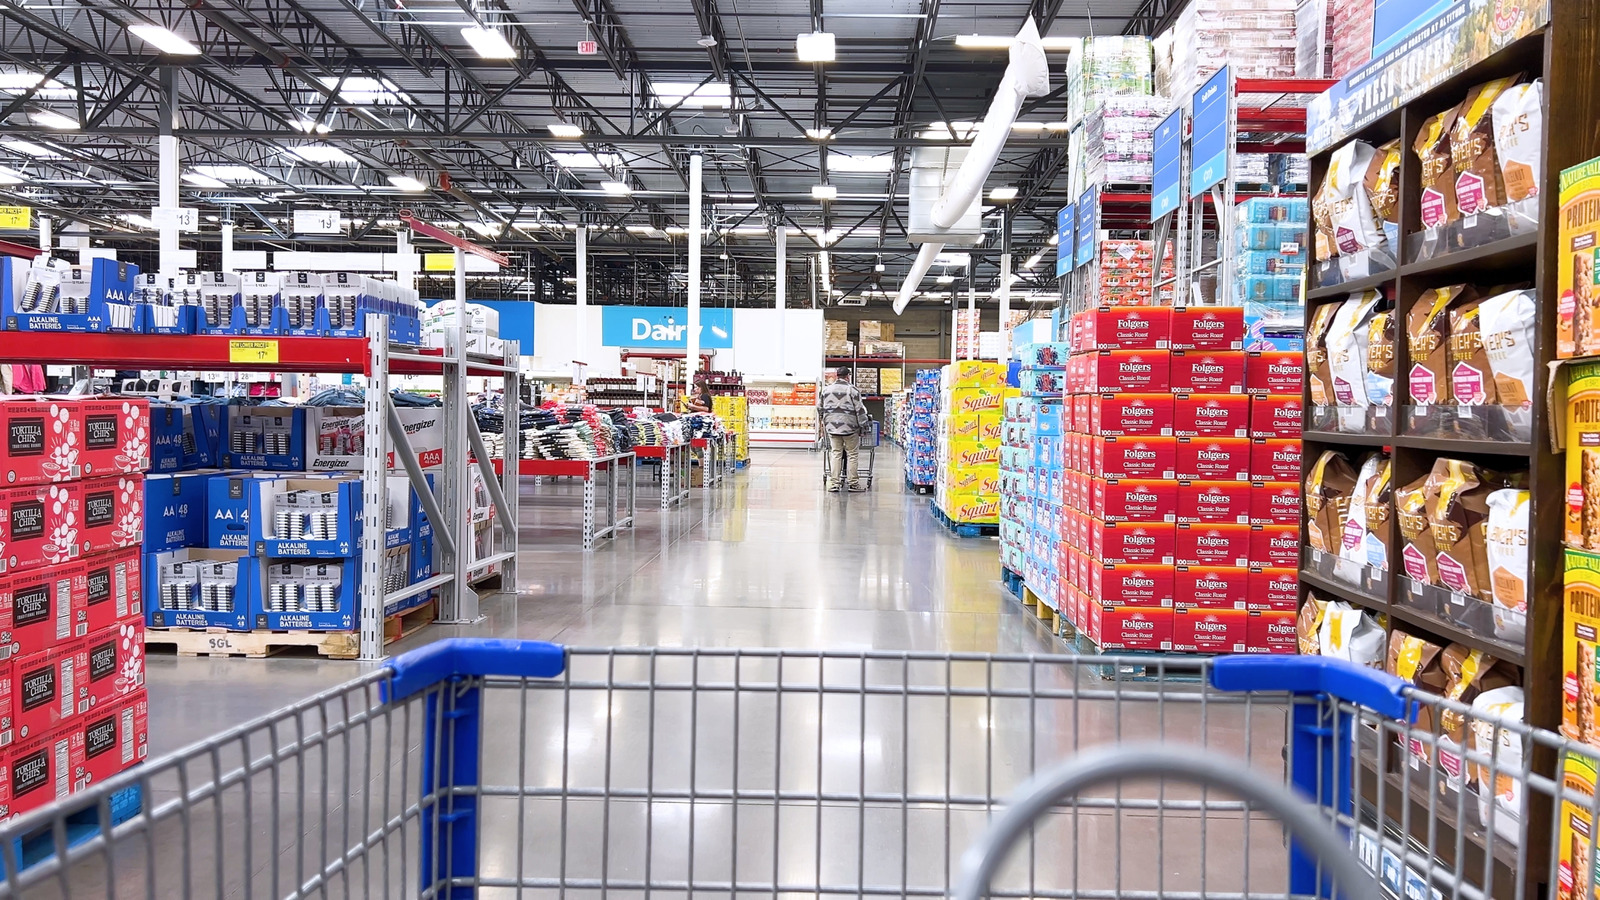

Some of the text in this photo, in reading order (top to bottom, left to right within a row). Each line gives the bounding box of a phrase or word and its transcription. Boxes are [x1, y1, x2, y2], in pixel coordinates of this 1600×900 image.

[581, 42, 594, 53] EXIT
[1349, 4, 1466, 88] SMOOTH TASTING AND SLOW ROASTED AT ALTITUDE
[1357, 32, 1451, 114] FRESH COFFEE
[1354, 110, 1376, 129] ROASTED
[1376, 101, 1392, 118] DAILY
[106, 288, 124, 302] AAA
[631, 317, 703, 341] Dair
[1117, 319, 1149, 330] Folgers
[1193, 319, 1225, 330] Folgers
[961, 366, 980, 380] Squirt
[1119, 362, 1151, 373] Folgers
[1192, 363, 1224, 374] Folgers
[1269, 364, 1301, 375] Folgers
[962, 391, 1001, 411] Squirt
[1121, 406, 1153, 417] Folgers
[1196, 407, 1228, 418] Folgers
[1274, 408, 1302, 419] Folger
[88, 422, 115, 433] TORTILLA
[321, 418, 350, 429] Energizer
[403, 418, 435, 432] nergizer
[958, 420, 977, 434] Squirt
[12, 426, 42, 436] TORTILLA
[93, 430, 110, 438] CHIPS
[17, 434, 36, 443] CHIPS
[156, 434, 182, 445] AAA 48
[960, 445, 998, 465] Squirt
[1124, 449, 1156, 460] Folgers
[1197, 450, 1229, 461] Folgers
[313, 458, 349, 469] Energizer
[958, 472, 977, 487] Squirt
[1125, 492, 1157, 503] Folgers
[87, 498, 112, 510] TORTILLA
[959, 498, 998, 519] Squirt
[13, 508, 42, 521] TORTILLA
[92, 507, 107, 516] CHIPS
[163, 504, 188, 517] AA 48
[214, 509, 234, 520] AA
[18, 517, 36, 527] CHIPS
[166, 529, 185, 539] ALKALINE
[166, 534, 185, 544] BATTERIES
[1123, 535, 1155, 546] Folgers
[1197, 536, 1229, 547] Folgers
[416, 568, 423, 579] AA
[88, 575, 108, 586] ORTILLA
[1122, 577, 1154, 588] Folgers
[89, 584, 104, 594] CHIPS
[16, 593, 47, 608] TORTILLA
[22, 601, 42, 614] CHIPS
[1122, 620, 1154, 631] Folgers
[1195, 622, 1227, 633] Folgers
[1268, 624, 1297, 635] Folger
[209, 638, 232, 648] SGL
[92, 648, 114, 665] TORTILLA
[96, 657, 111, 669] CHIPS
[24, 673, 53, 691] TORTILLA
[30, 682, 48, 696] CHIPS
[88, 723, 114, 742] TORTILLA
[93, 733, 110, 745] CHIPS
[15, 757, 46, 778] TORTILLA
[21, 767, 40, 783] CHIPS
